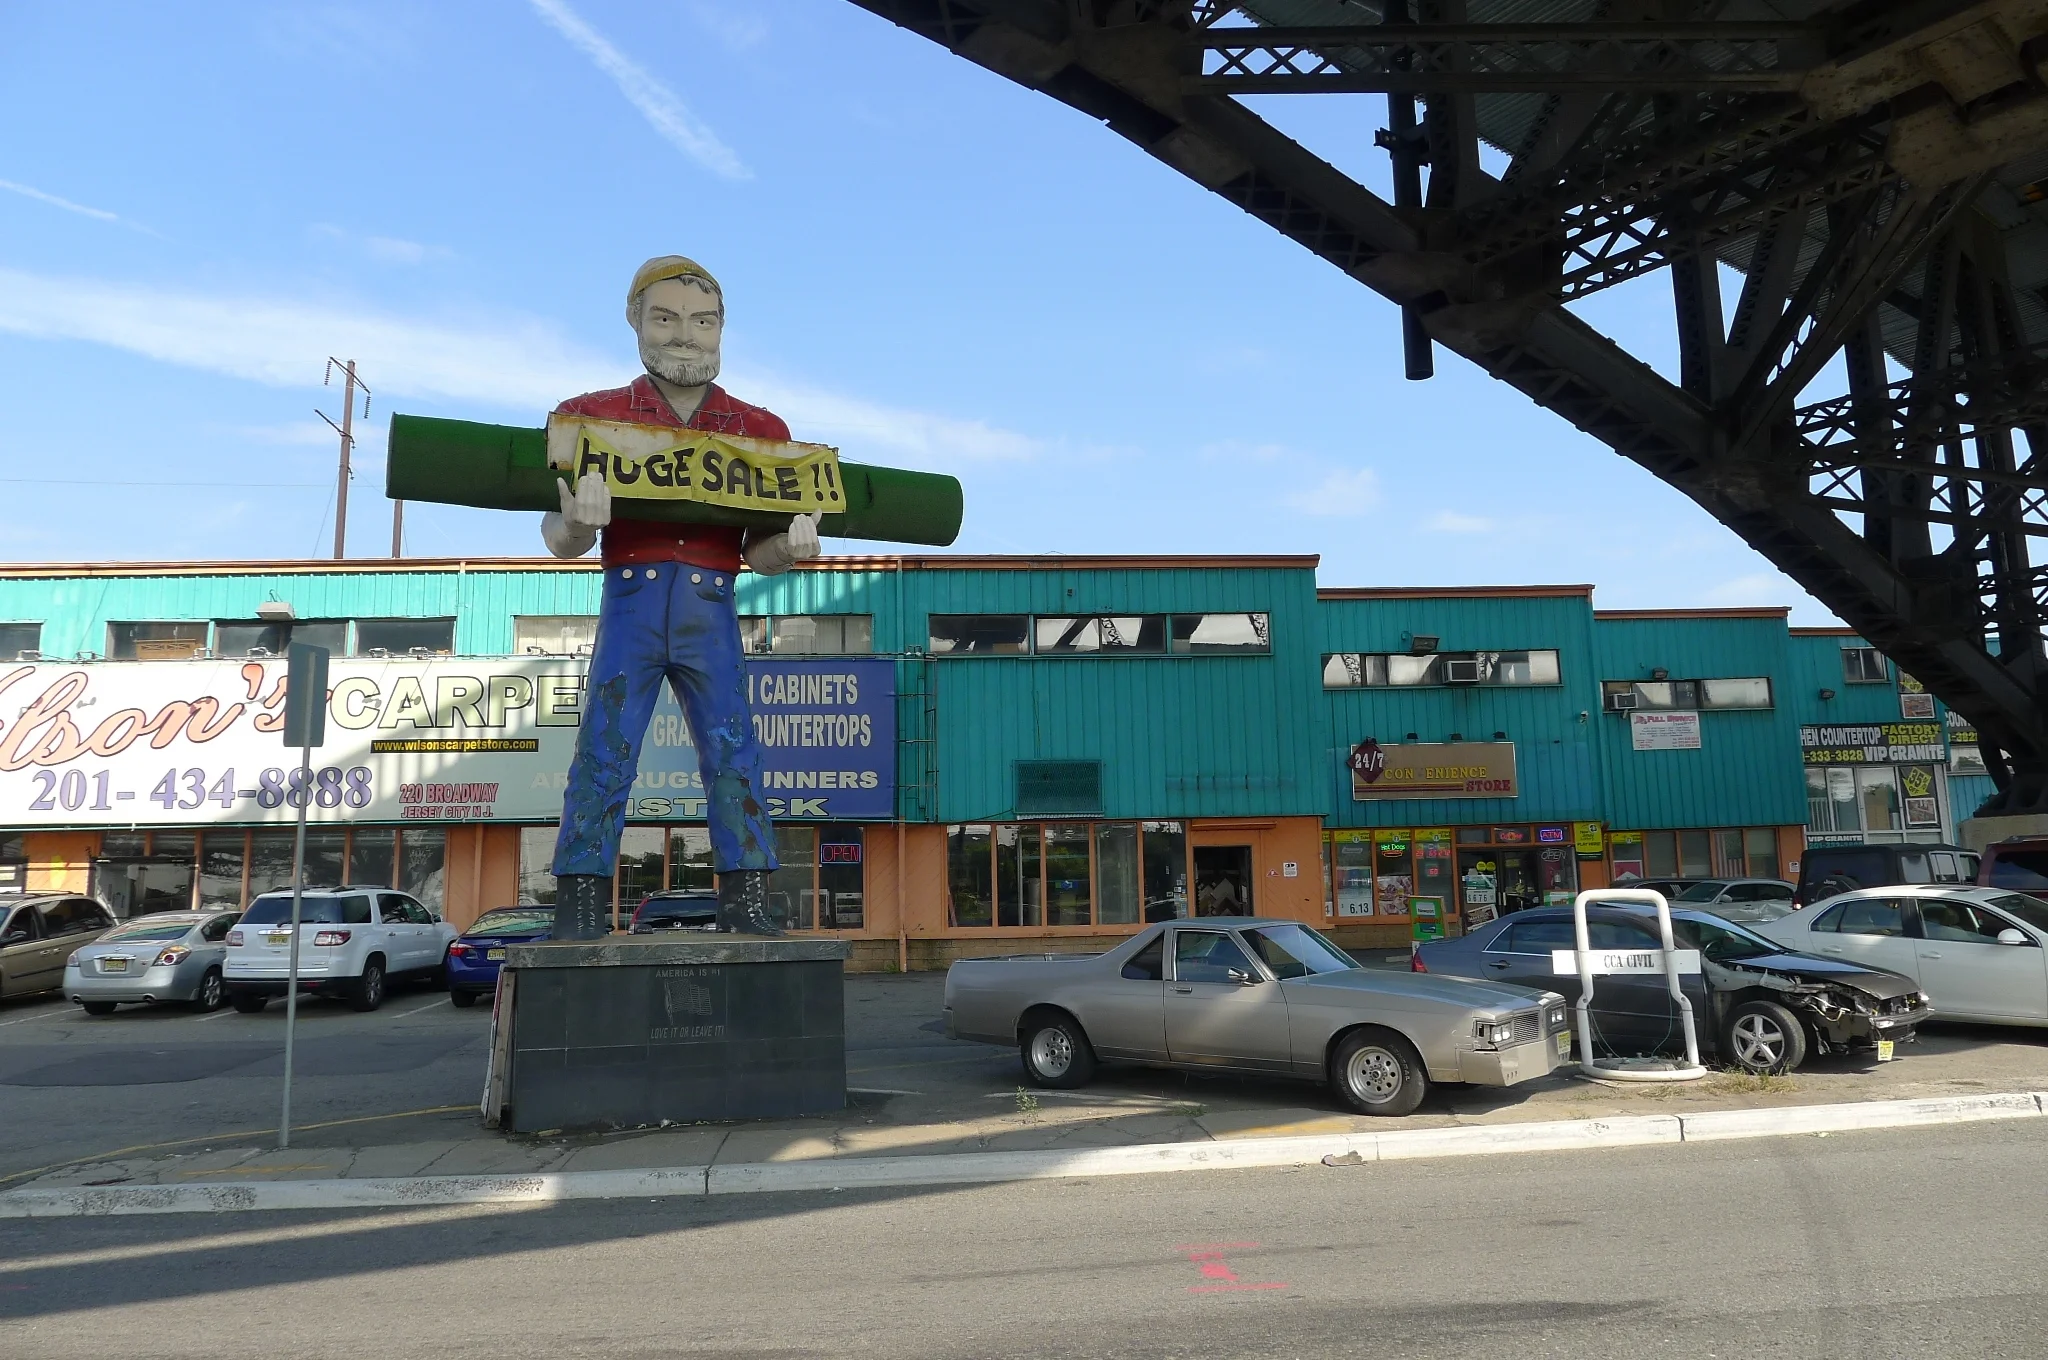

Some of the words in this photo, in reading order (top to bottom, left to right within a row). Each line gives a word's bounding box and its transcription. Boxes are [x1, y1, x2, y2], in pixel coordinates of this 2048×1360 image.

[578, 437, 695, 488] HUGE
[701, 450, 802, 501] SALE
[760, 674, 858, 705] CABINETS
[330, 675, 588, 730] CARPE
[1820, 726, 1882, 746] COUNTERTOP
[1881, 724, 1941, 735] FACTORY
[373, 740, 536, 752] www.wilsonscarpetstore.com
[1888, 734, 1936, 745] DIRECT
[1863, 746, 1888, 762] VIP
[1888, 744, 1946, 761] GRANITE
[1354, 750, 1384, 772] 24/7
[1465, 779, 1512, 792] STORE
[399, 784, 424, 804] 220
[426, 783, 500, 804] BROADWAY
[400, 806, 443, 818] JERSEY
[444, 805, 471, 818] CITY
[1541, 831, 1561, 839] ATM
[823, 845, 859, 862] OPEN
[1541, 849, 1567, 860] OPEN
[1349, 903, 1370, 915] 6.13
[1604, 954, 1624, 969] CCA
[1626, 953, 1655, 969] CIVIL
[655, 969, 695, 978] AMERICA
[699, 968, 708, 977] IS
[650, 1027, 669, 1039] LOVE
[670, 1027, 679, 1038] IT
[680, 1026, 690, 1038] OR
[691, 1025, 713, 1037] LEAVE
